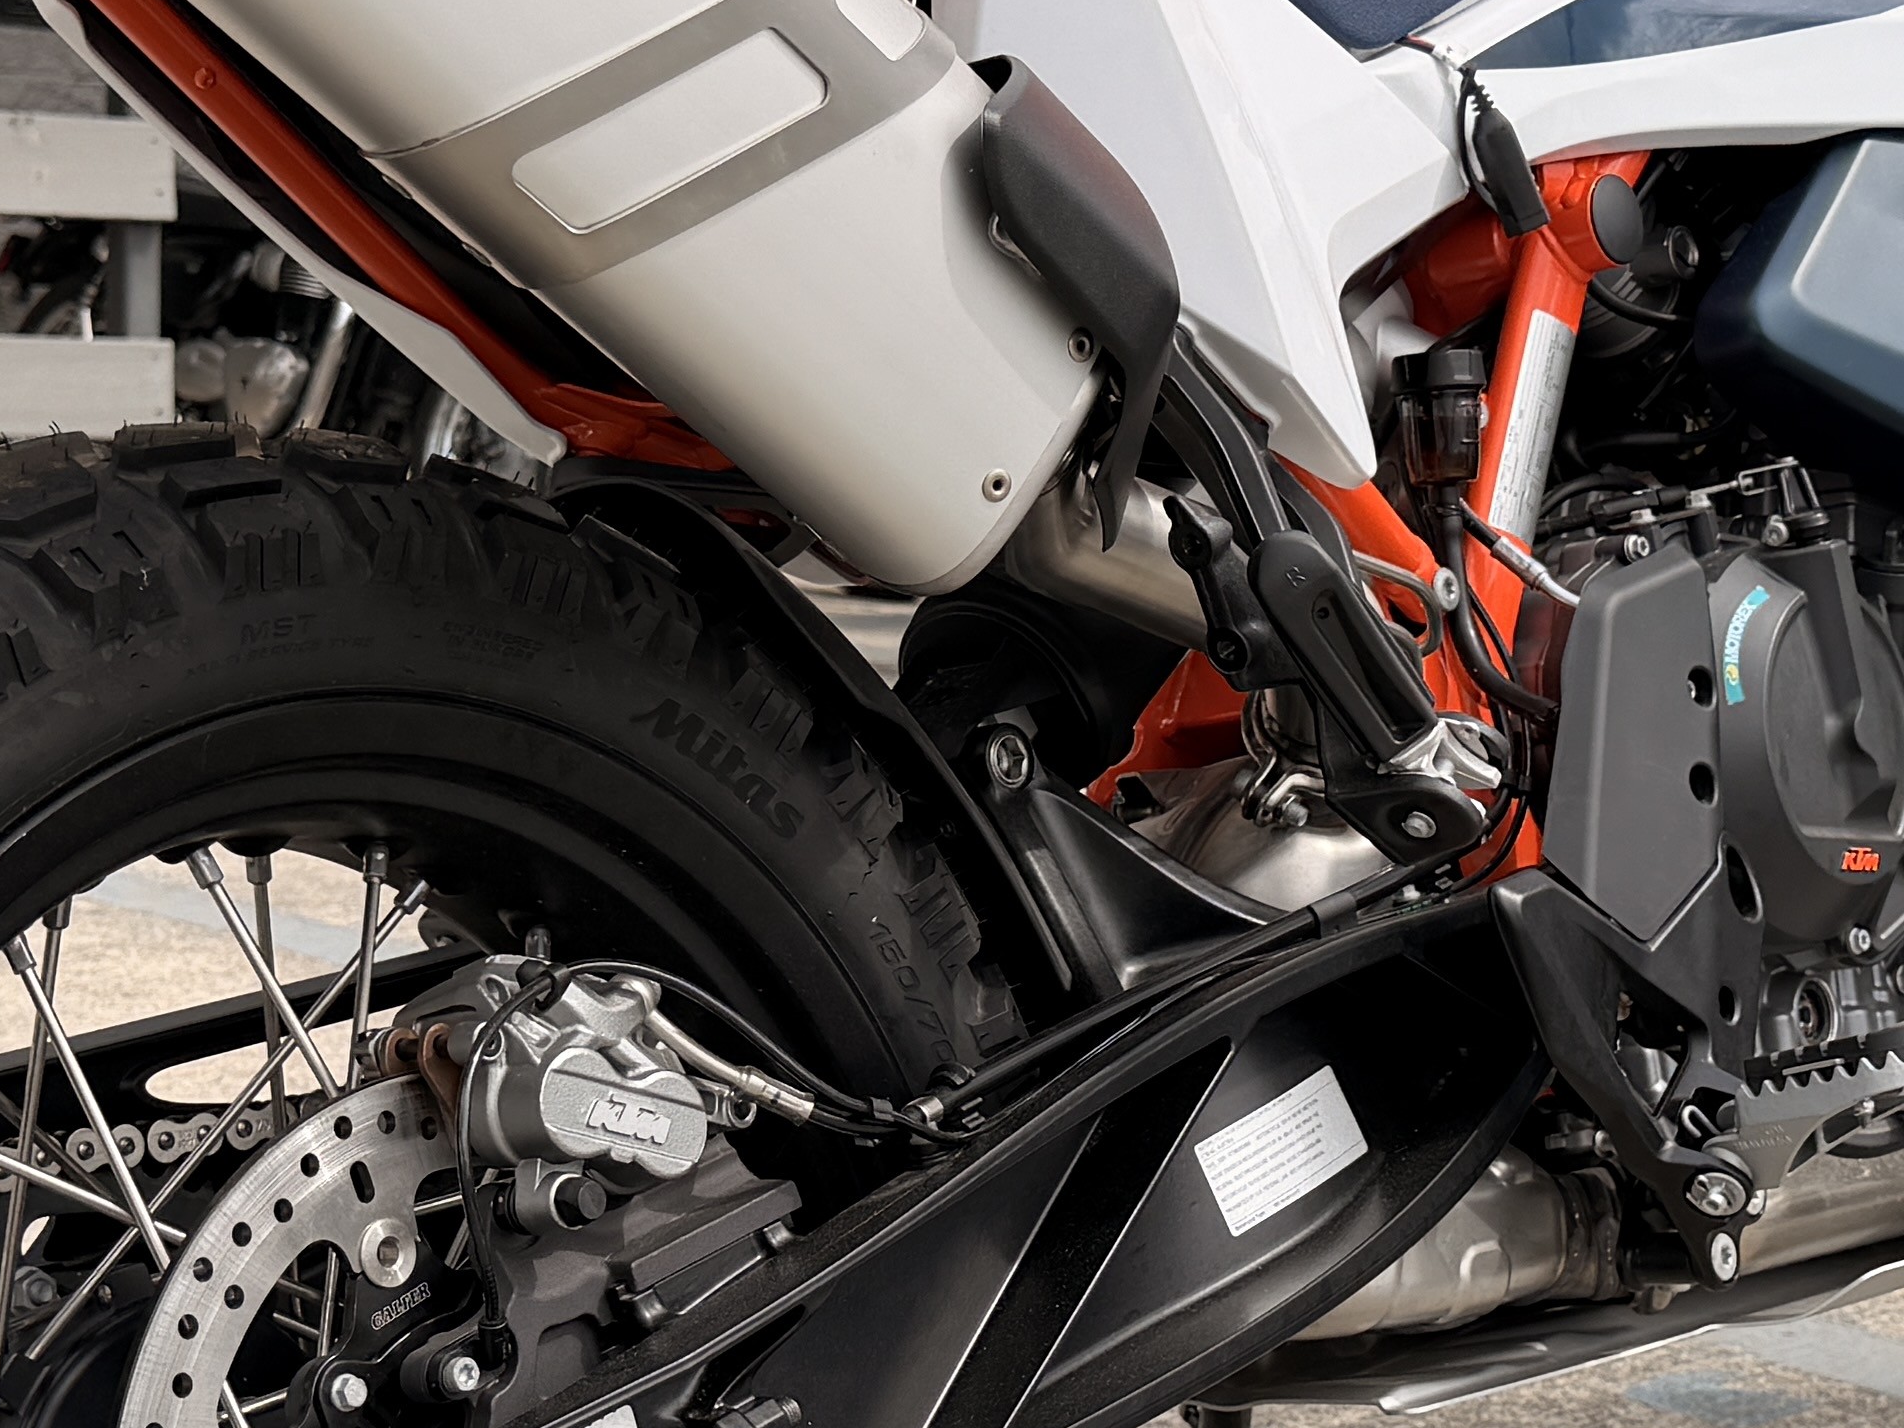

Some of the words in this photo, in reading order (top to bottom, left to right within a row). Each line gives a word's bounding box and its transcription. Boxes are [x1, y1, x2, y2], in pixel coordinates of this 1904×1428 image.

[1724, 601, 1757, 664] MOTOREX
[629, 698, 805, 838] Mitas
[1841, 846, 1879, 872] KTM
[870, 922, 958, 1062] 150/70
[586, 1091, 672, 1145] KTM
[369, 1282, 432, 1331] GALFER
